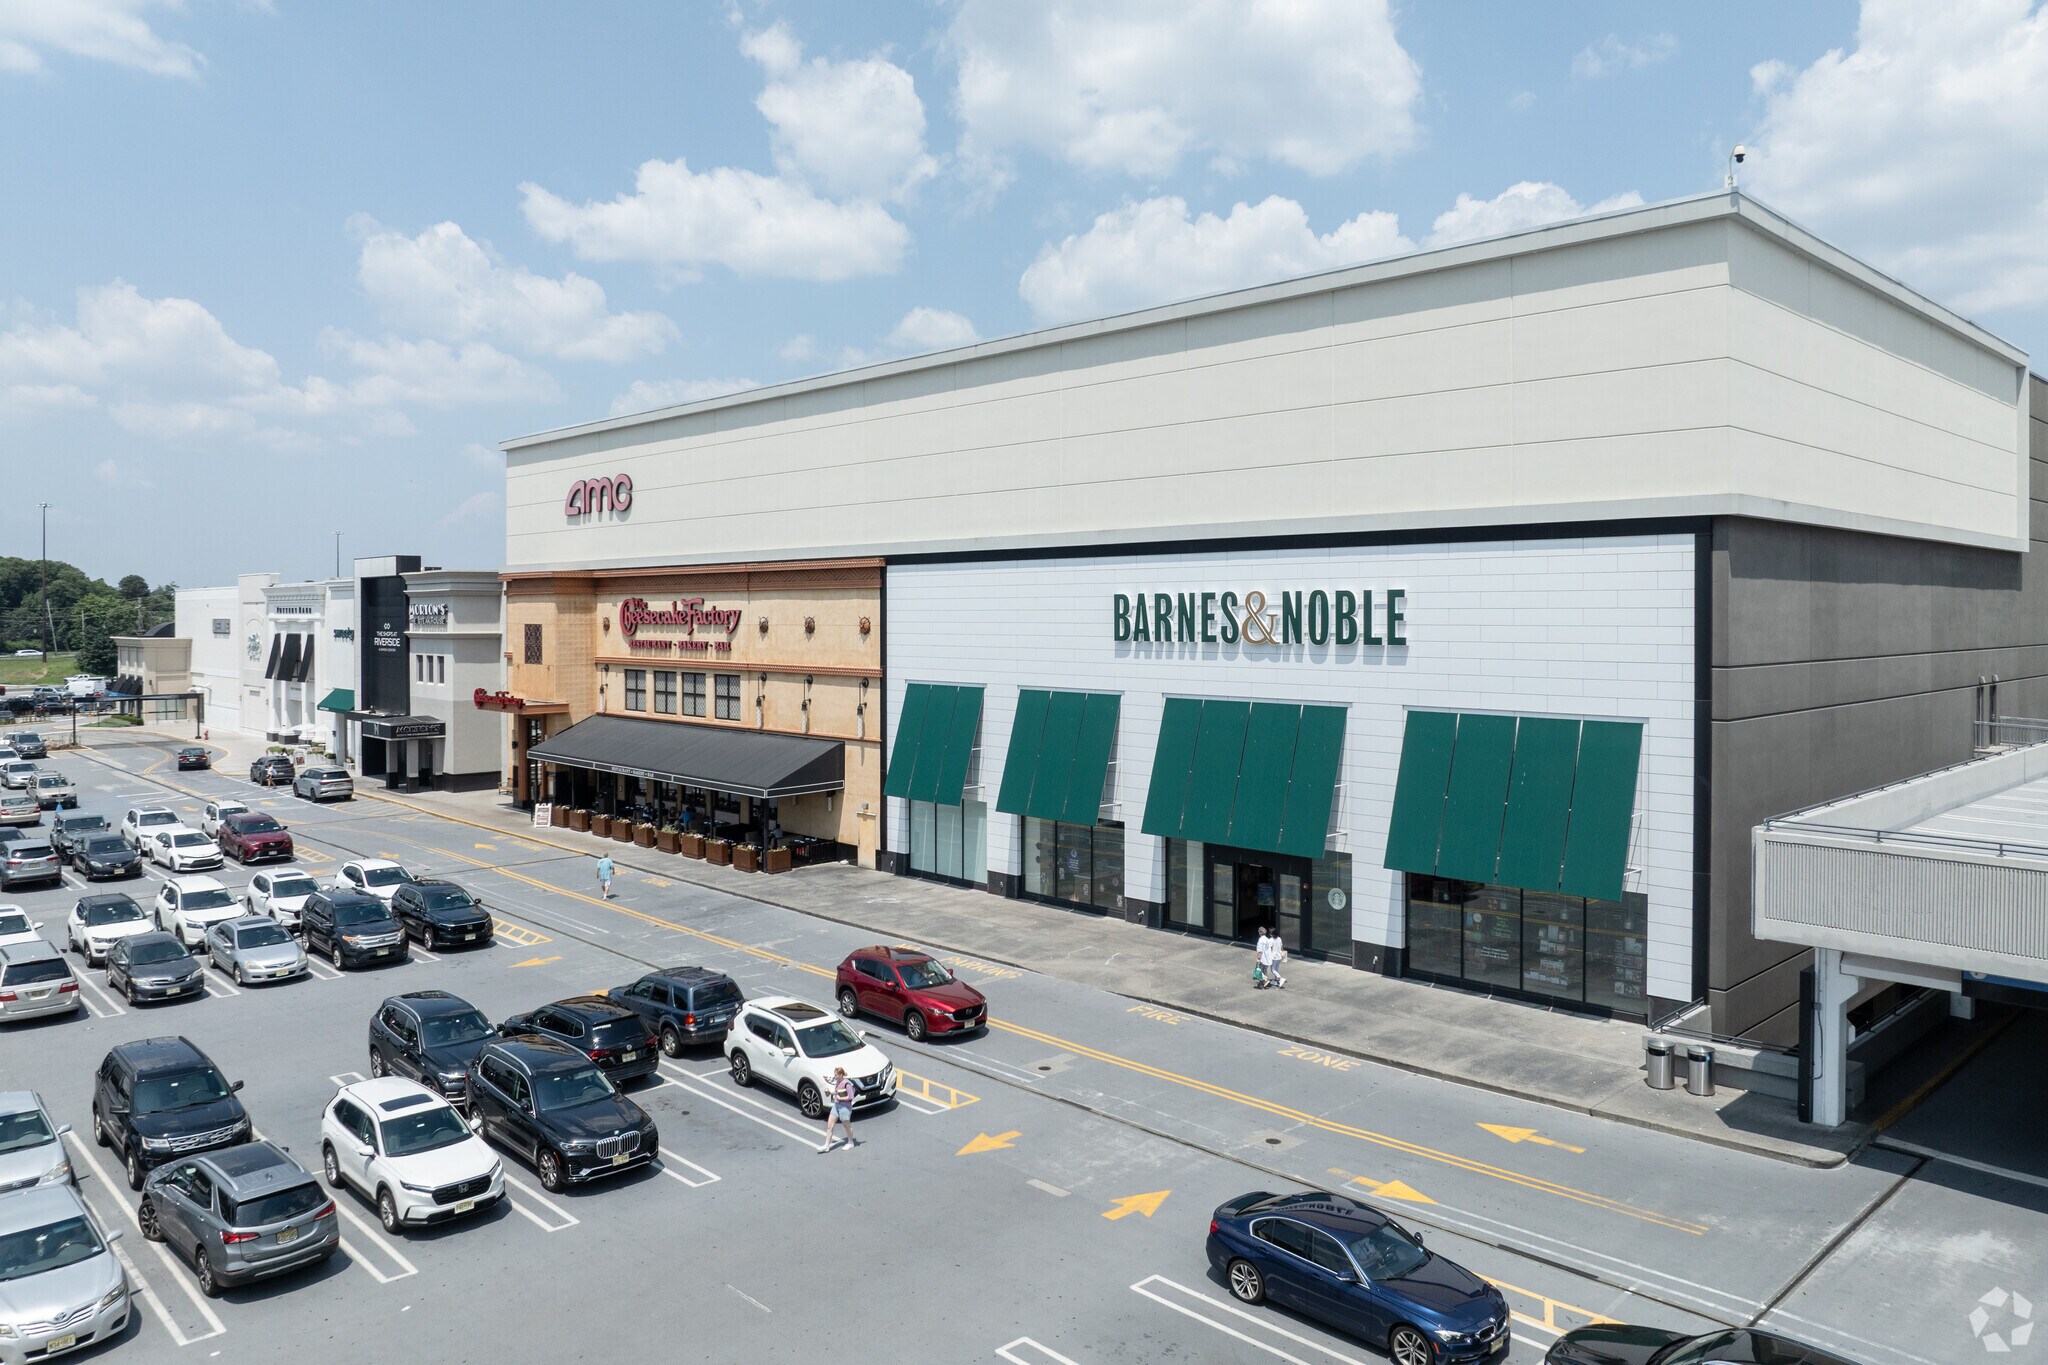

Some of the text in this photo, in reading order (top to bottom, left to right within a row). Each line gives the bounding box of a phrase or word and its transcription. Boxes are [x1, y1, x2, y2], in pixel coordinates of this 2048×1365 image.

[410, 604, 446, 615] MORTON'S
[619, 598, 742, 636] Cheesecake Factory
[374, 637, 401, 647] RIVERSIDE
[629, 640, 732, 651] RESTAURANT BAKERY BAR
[941, 955, 1024, 980] PARKING
[1126, 1005, 1191, 1025] FIRE
[1277, 1046, 1361, 1072] ZONE
